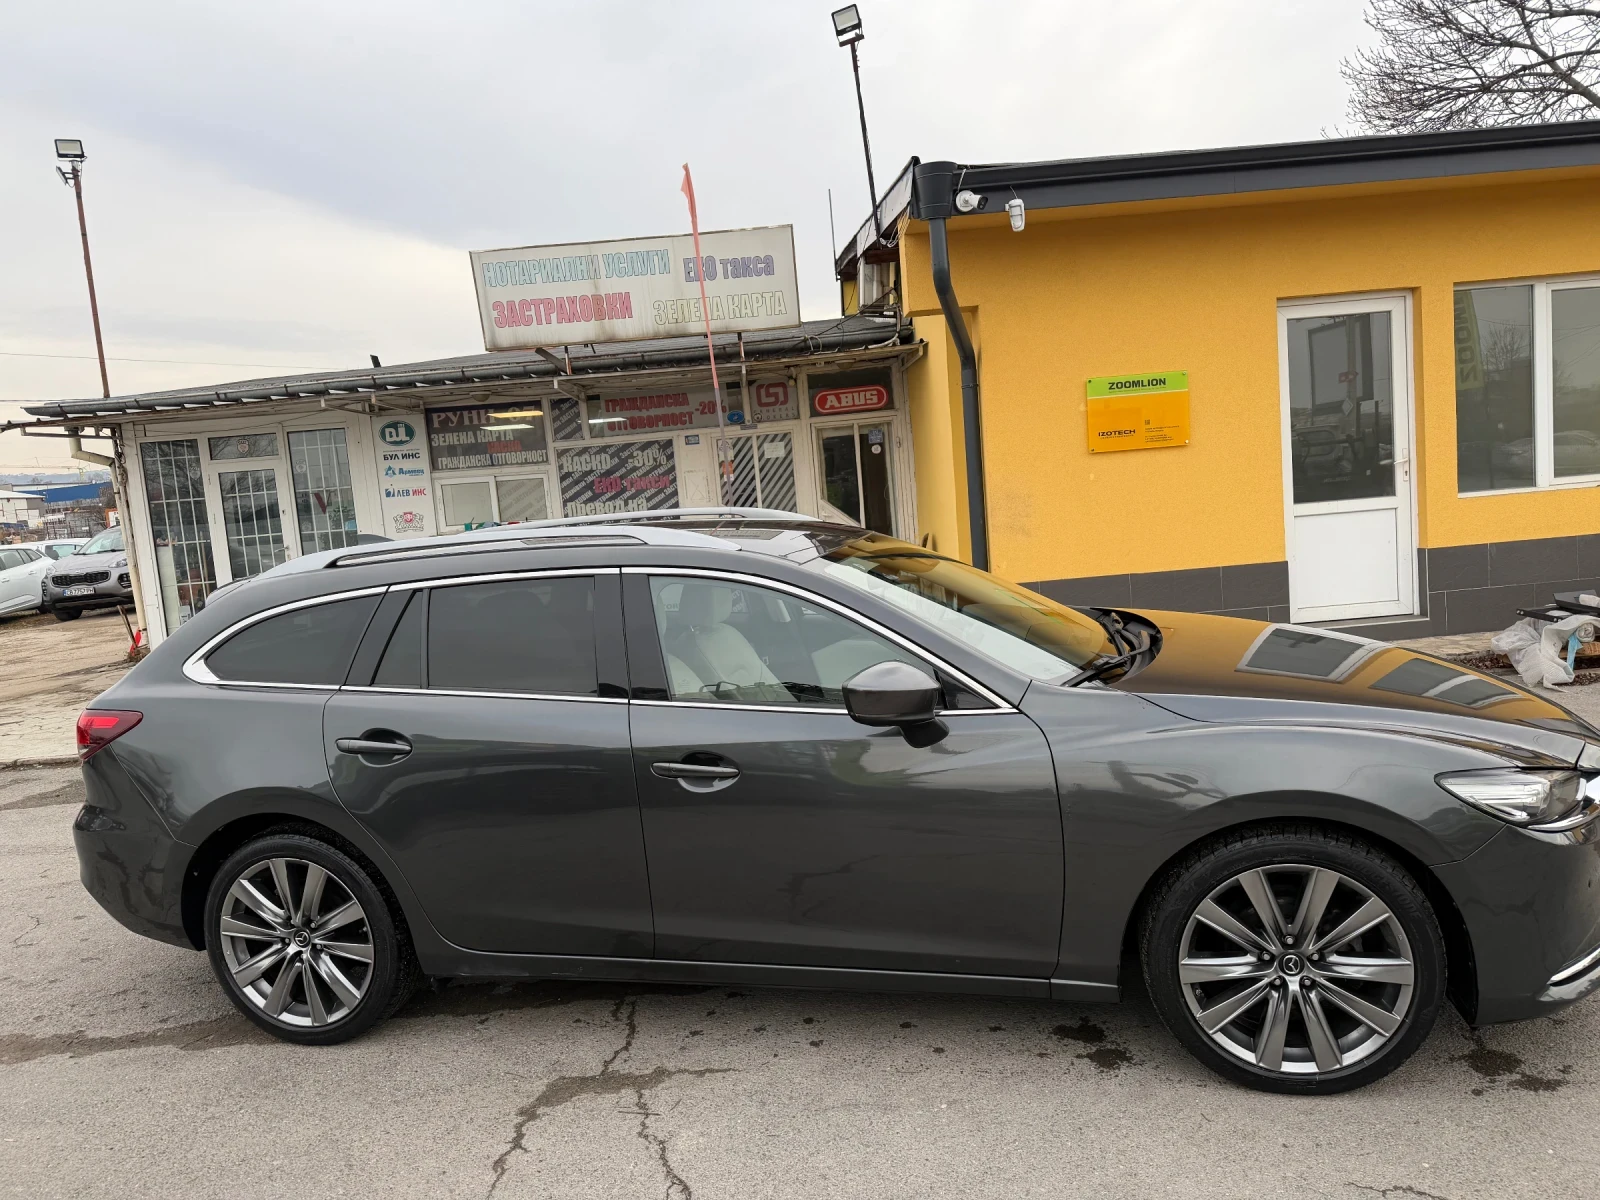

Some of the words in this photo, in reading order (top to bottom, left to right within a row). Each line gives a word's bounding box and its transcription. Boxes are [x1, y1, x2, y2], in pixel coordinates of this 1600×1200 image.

[482, 254, 601, 287] НОТАРИАЛНИ
[602, 249, 671, 279] УСЛУГИ
[720, 254, 775, 280] такса
[492, 291, 633, 329] ЗАСТРАХОВКИ
[726, 290, 788, 320] КАРТА
[1107, 378, 1167, 390] ZOOMLION
[604, 393, 690, 413] ГРАЖДАНСКА
[825, 390, 879, 409] ABUS
[431, 409, 497, 428] РУНИ
[431, 431, 475, 447] ЗЕЛЕНА
[476, 428, 514, 443] КАРТА
[1098, 429, 1136, 437] IZOTECH
[383, 453, 400, 461] БУЛ
[401, 452, 421, 460] ИНС
[438, 452, 492, 469] ГРАЖДАНСКА
[492, 449, 547, 465] ОТГОВОРНОСТ
[562, 453, 611, 473] КАСКО
[627, 449, 667, 467] -30%
[397, 489, 410, 497] ЛЕВ
[594, 475, 622, 494] ЕКО
[625, 474, 670, 491] такси
